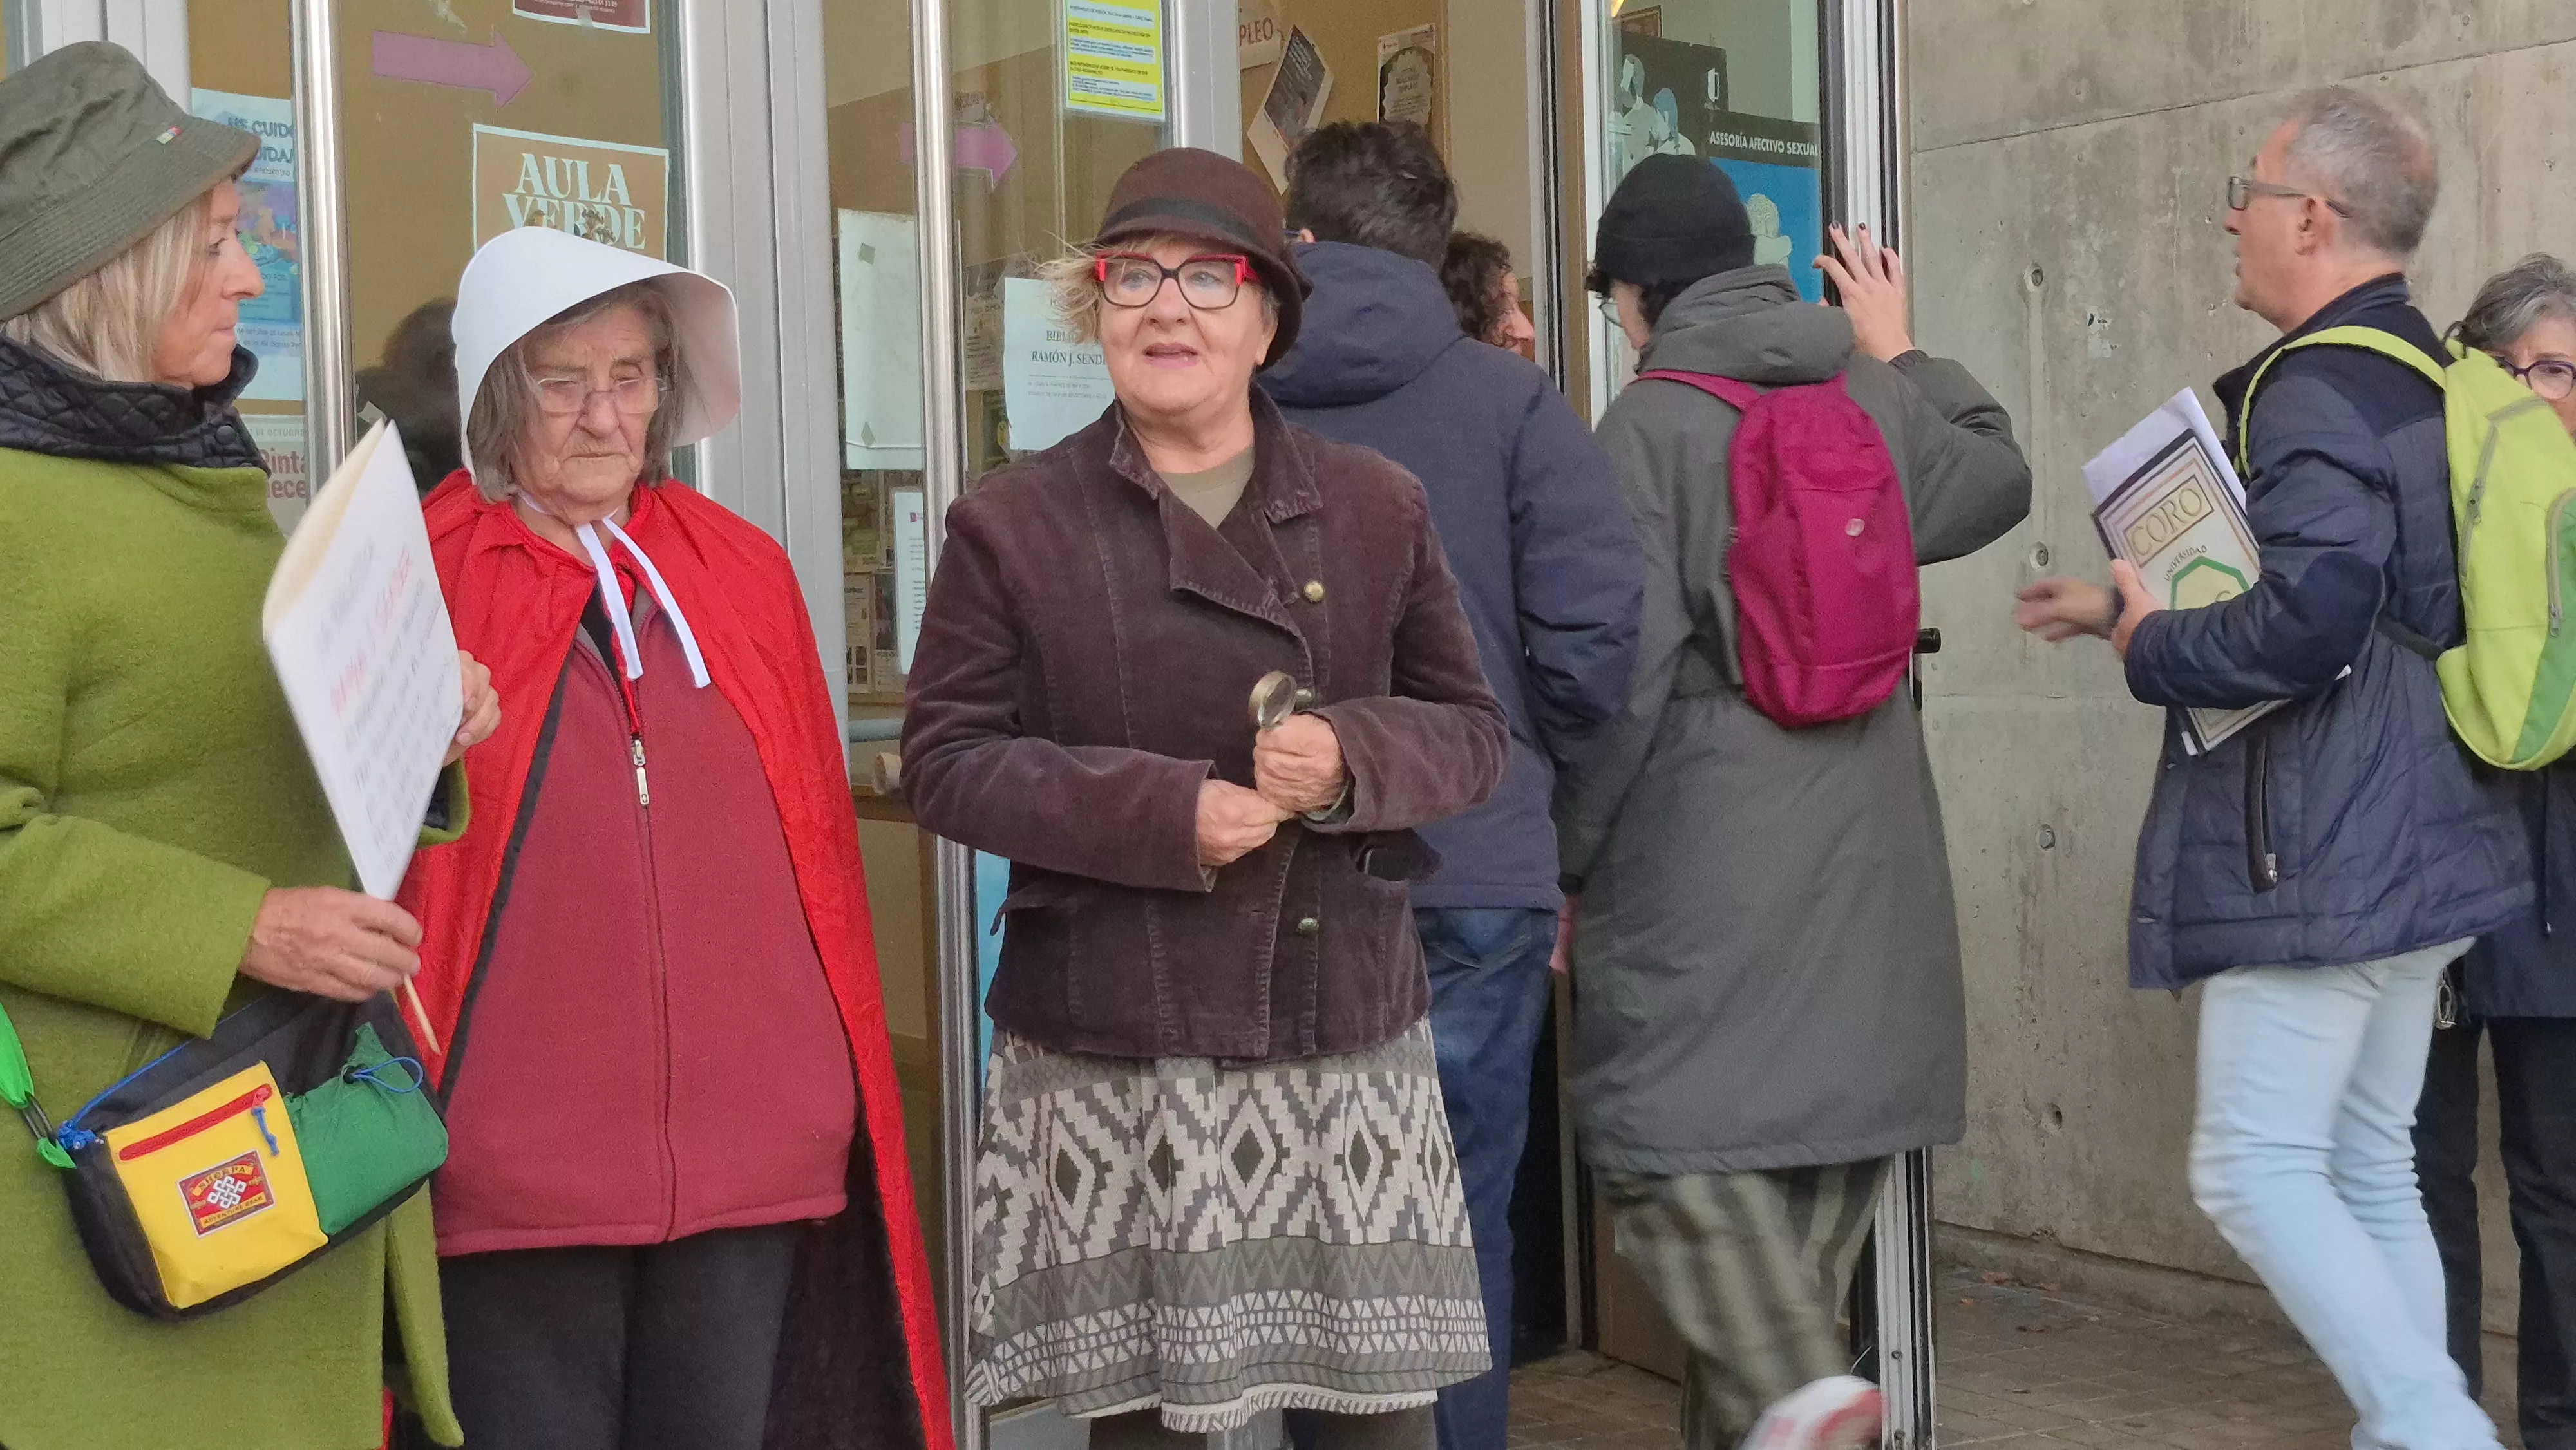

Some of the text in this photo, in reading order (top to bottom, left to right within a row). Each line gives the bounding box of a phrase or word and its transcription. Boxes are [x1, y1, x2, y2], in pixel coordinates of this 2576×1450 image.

[1239, 17, 1274, 47] PLEO
[1710, 131, 1819, 156] ASESORÍA AFECTIVO SEXUAL
[514, 153, 633, 207] AULA
[502, 194, 646, 249] VERDE
[1032, 349, 1066, 363] RAMÓN
[1068, 353, 1074, 367] J.
[2132, 487, 2202, 556] CORO
[2164, 545, 2208, 582] UNIVERSIDAD
